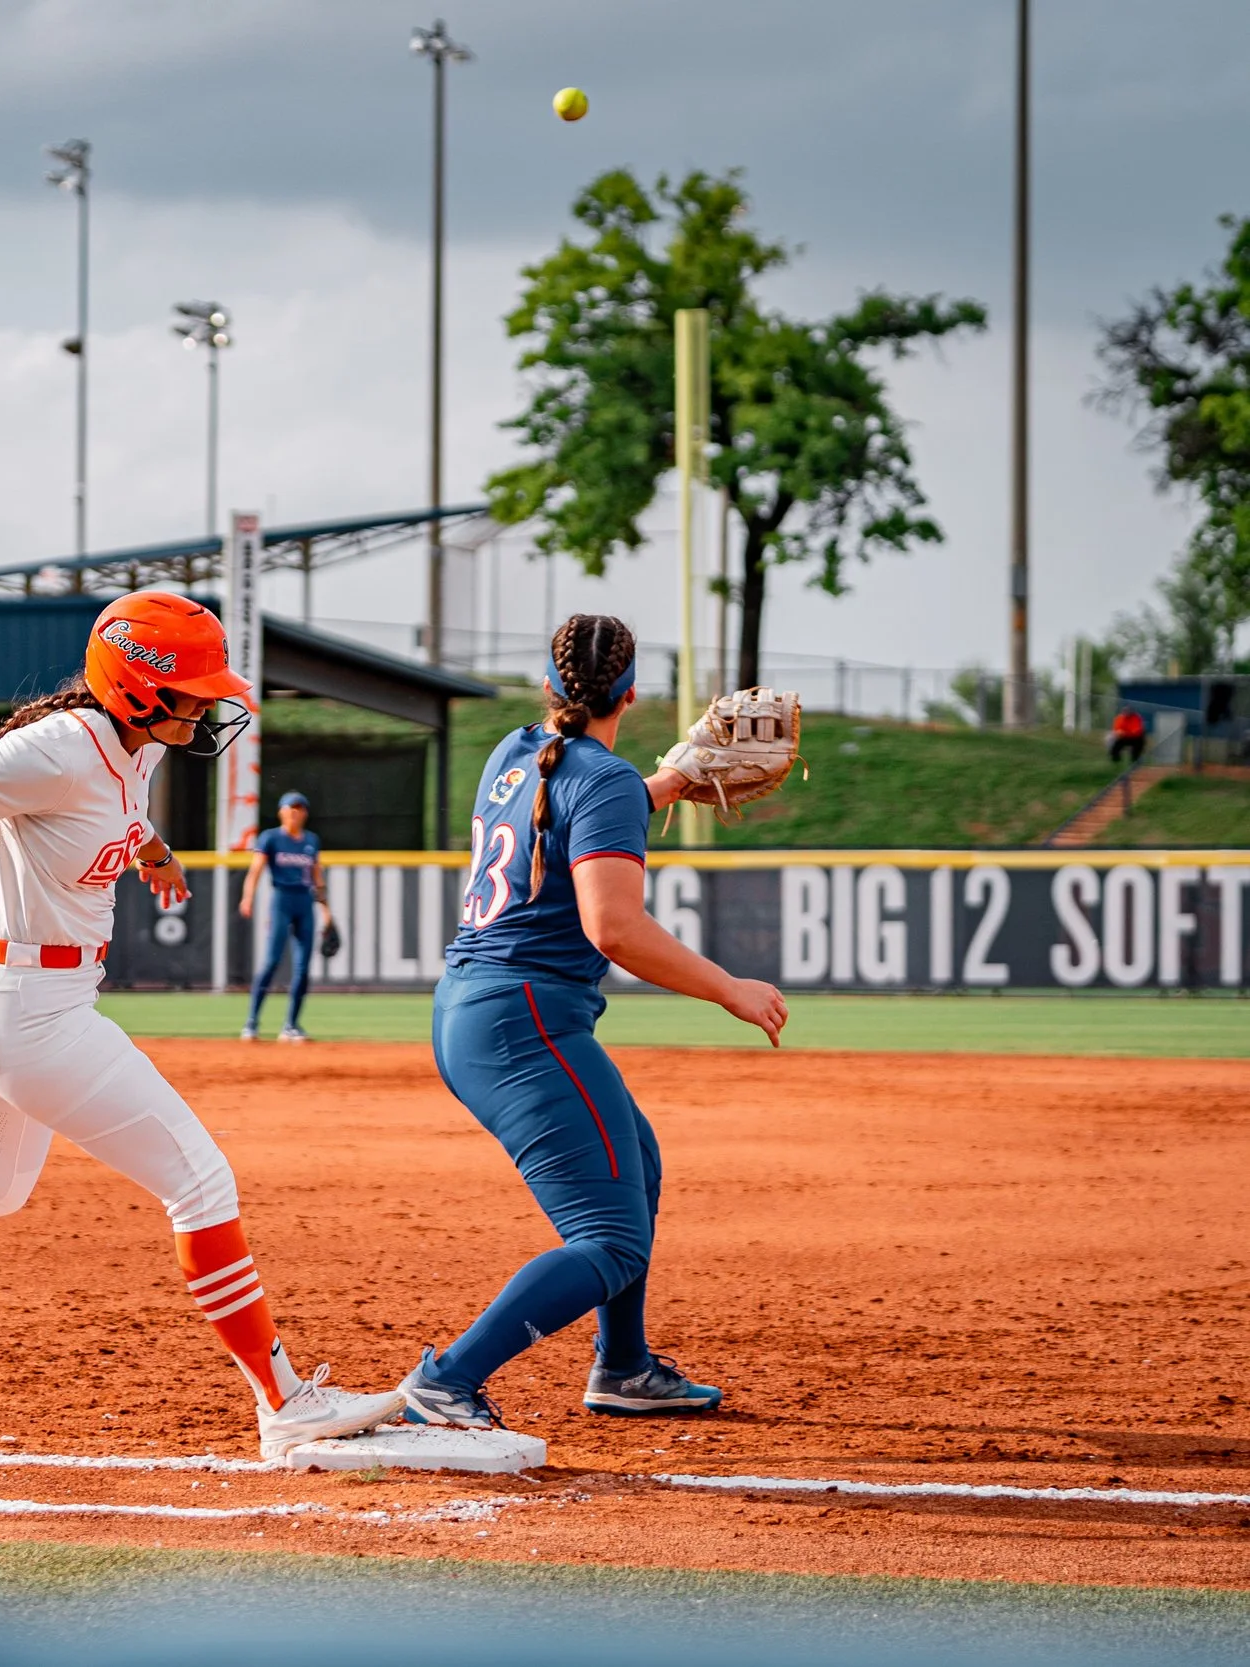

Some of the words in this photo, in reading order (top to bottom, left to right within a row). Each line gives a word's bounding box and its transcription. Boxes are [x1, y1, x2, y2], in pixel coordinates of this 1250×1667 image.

[104, 620, 176, 675] Cowgirls
[780, 864, 908, 984] BIG
[930, 863, 1011, 986] 12
